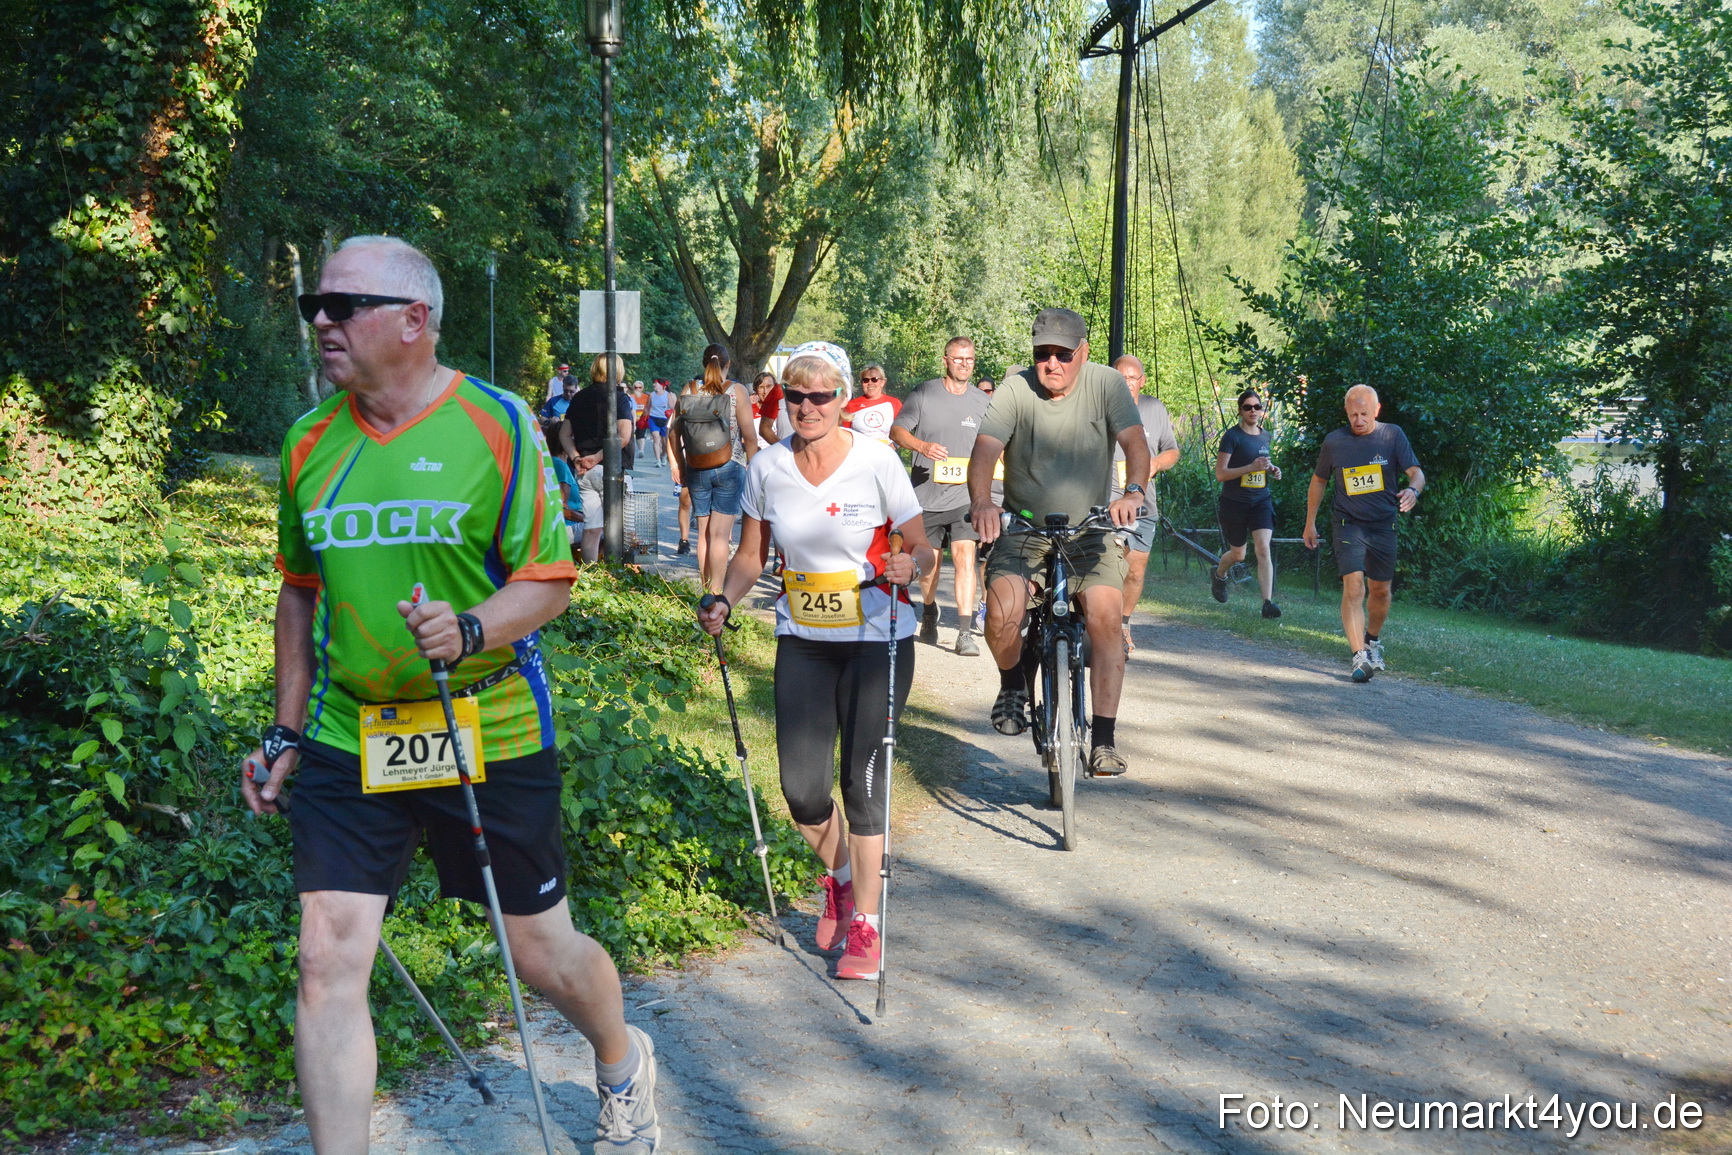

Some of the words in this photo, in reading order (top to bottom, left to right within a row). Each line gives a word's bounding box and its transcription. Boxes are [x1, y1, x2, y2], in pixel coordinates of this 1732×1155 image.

[942, 466, 962, 476] 313
[1247, 473, 1262, 483] 310
[1352, 474, 1375, 487] 314
[302, 499, 472, 551] BOCK
[841, 518, 873, 527] Josefine
[800, 592, 843, 613] 245
[802, 611, 821, 619] Glaser
[385, 731, 451, 767] 207
[382, 764, 428, 777] Lehmeyer
[430, 763, 457, 773] Jürge
